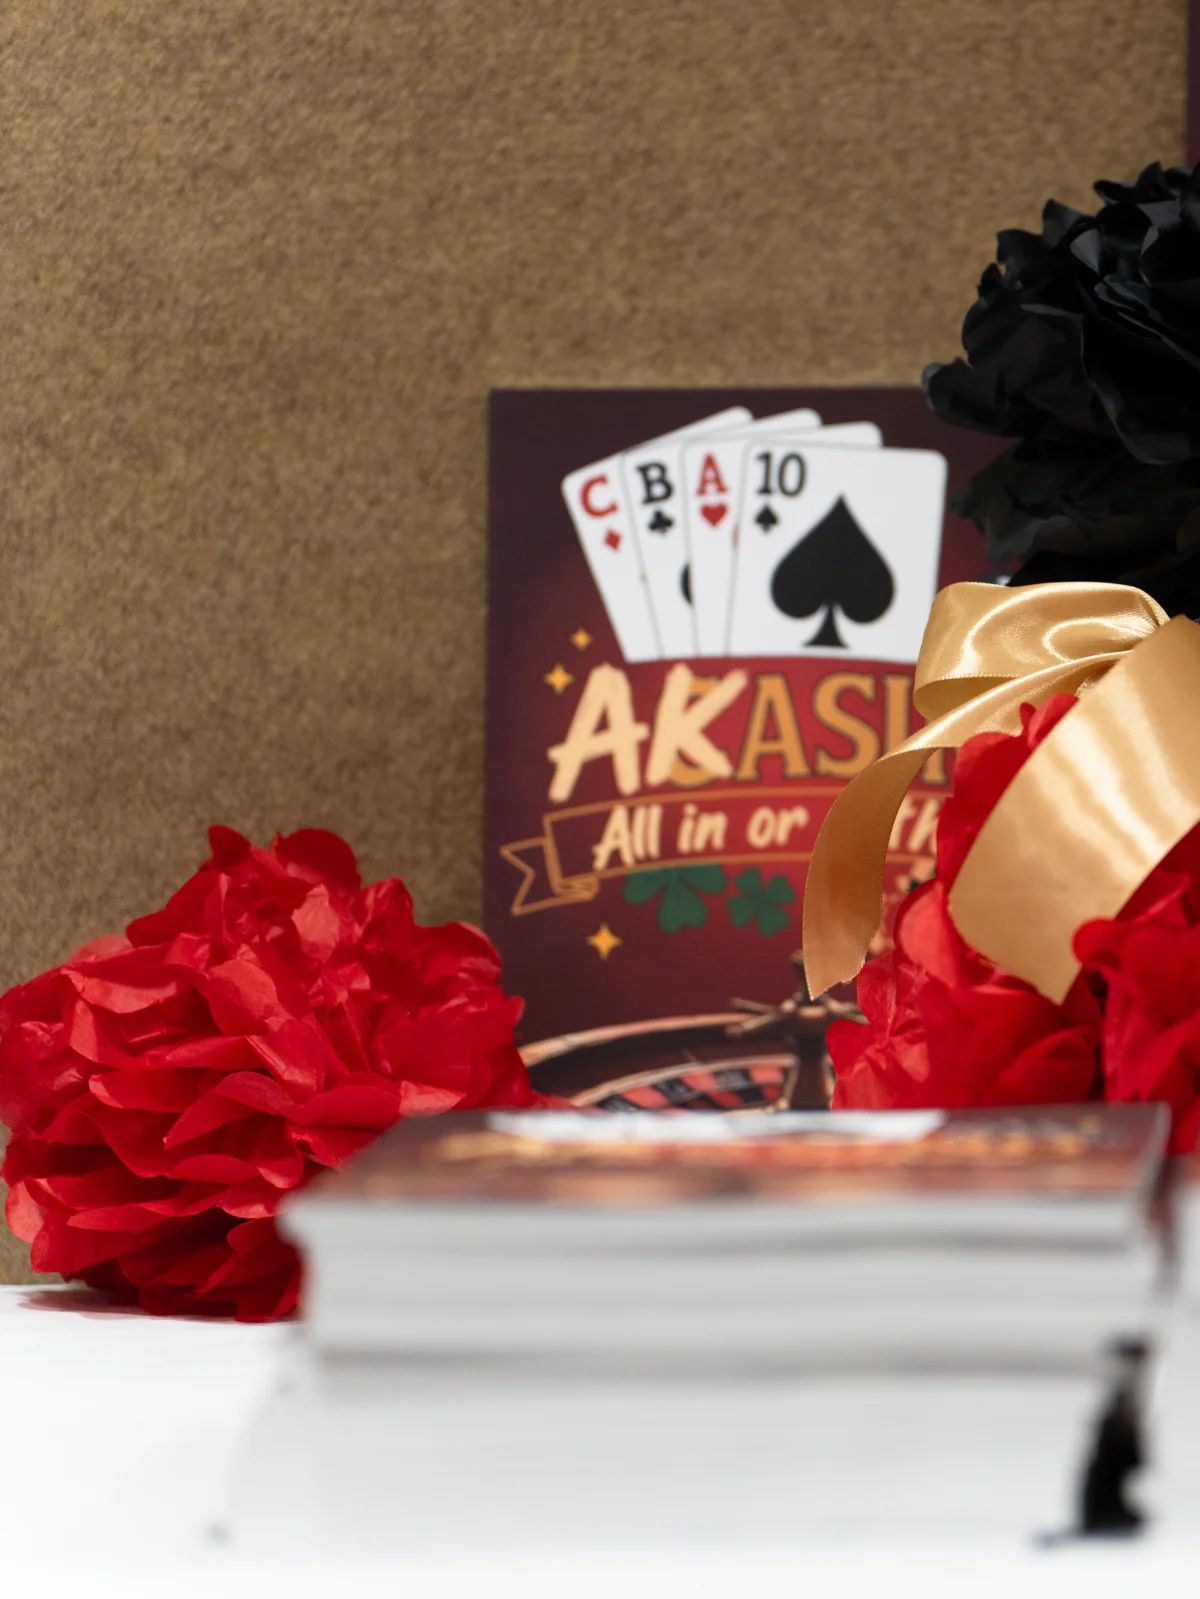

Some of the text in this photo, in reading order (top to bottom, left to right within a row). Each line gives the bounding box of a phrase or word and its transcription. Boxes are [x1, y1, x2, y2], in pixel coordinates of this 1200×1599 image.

[578, 451, 807, 520] C B A 10
[547, 663, 949, 802] AKASI
[592, 802, 809, 871] All in or
